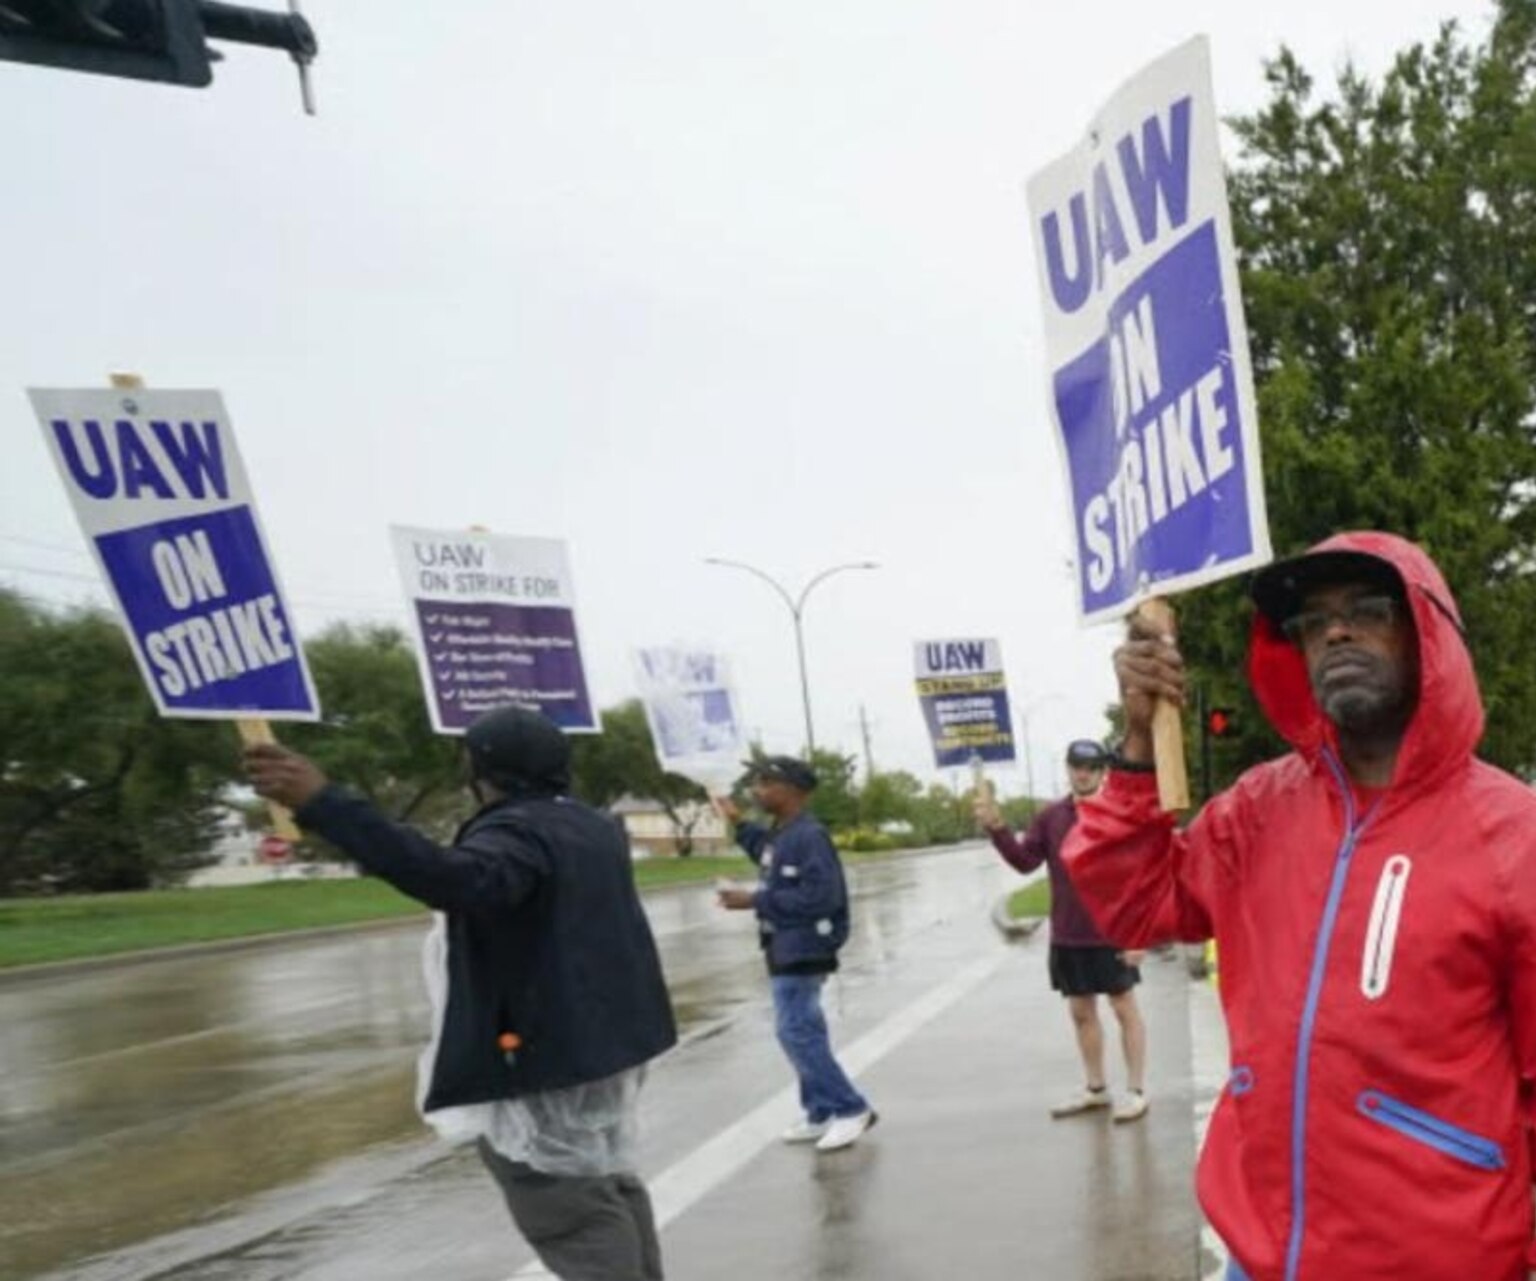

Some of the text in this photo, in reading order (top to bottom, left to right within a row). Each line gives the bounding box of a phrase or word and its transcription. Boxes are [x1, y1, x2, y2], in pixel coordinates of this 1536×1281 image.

[1041, 96, 1192, 314] UAW
[50, 420, 229, 499] UAW
[1083, 365, 1236, 594] STRIKE
[151, 529, 226, 610] ON
[413, 542, 484, 568] UAW
[420, 570, 560, 598] ON STRIKE FOR
[144, 593, 294, 698] STRIKE
[926, 641, 984, 672] UAW
